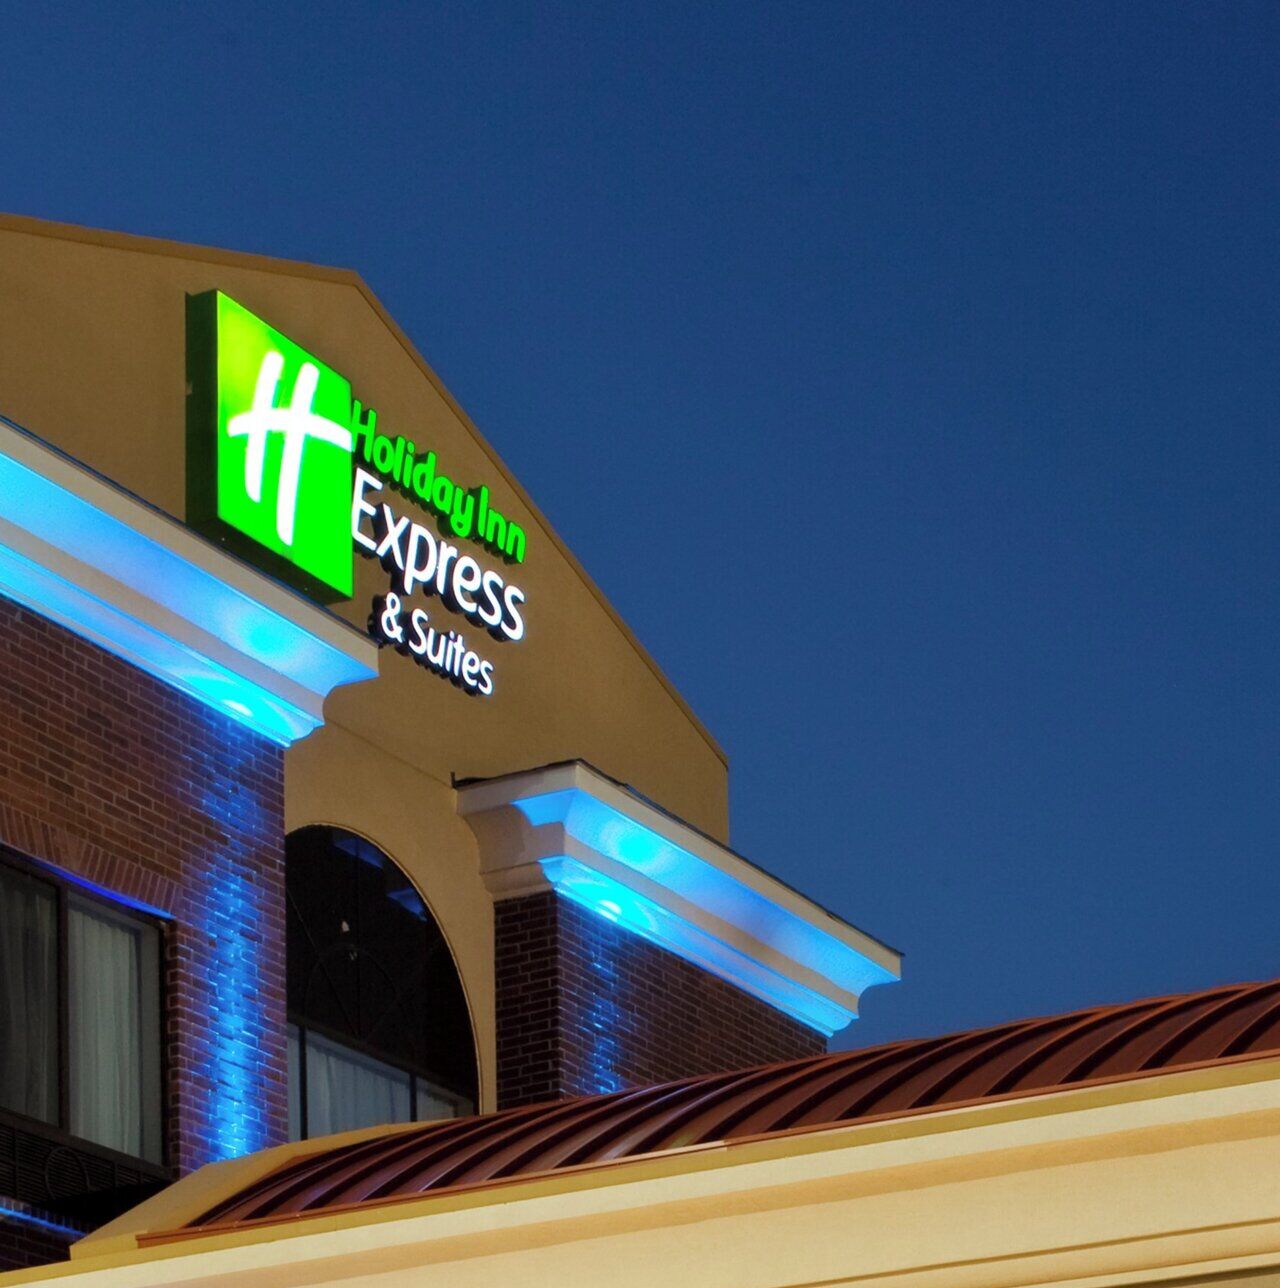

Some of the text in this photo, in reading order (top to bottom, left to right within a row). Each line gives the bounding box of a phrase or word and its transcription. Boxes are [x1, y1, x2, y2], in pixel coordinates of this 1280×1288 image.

[352, 400, 526, 563] Holiday Inn
[352, 467, 525, 641] Express
[381, 592, 494, 695] & Suites
